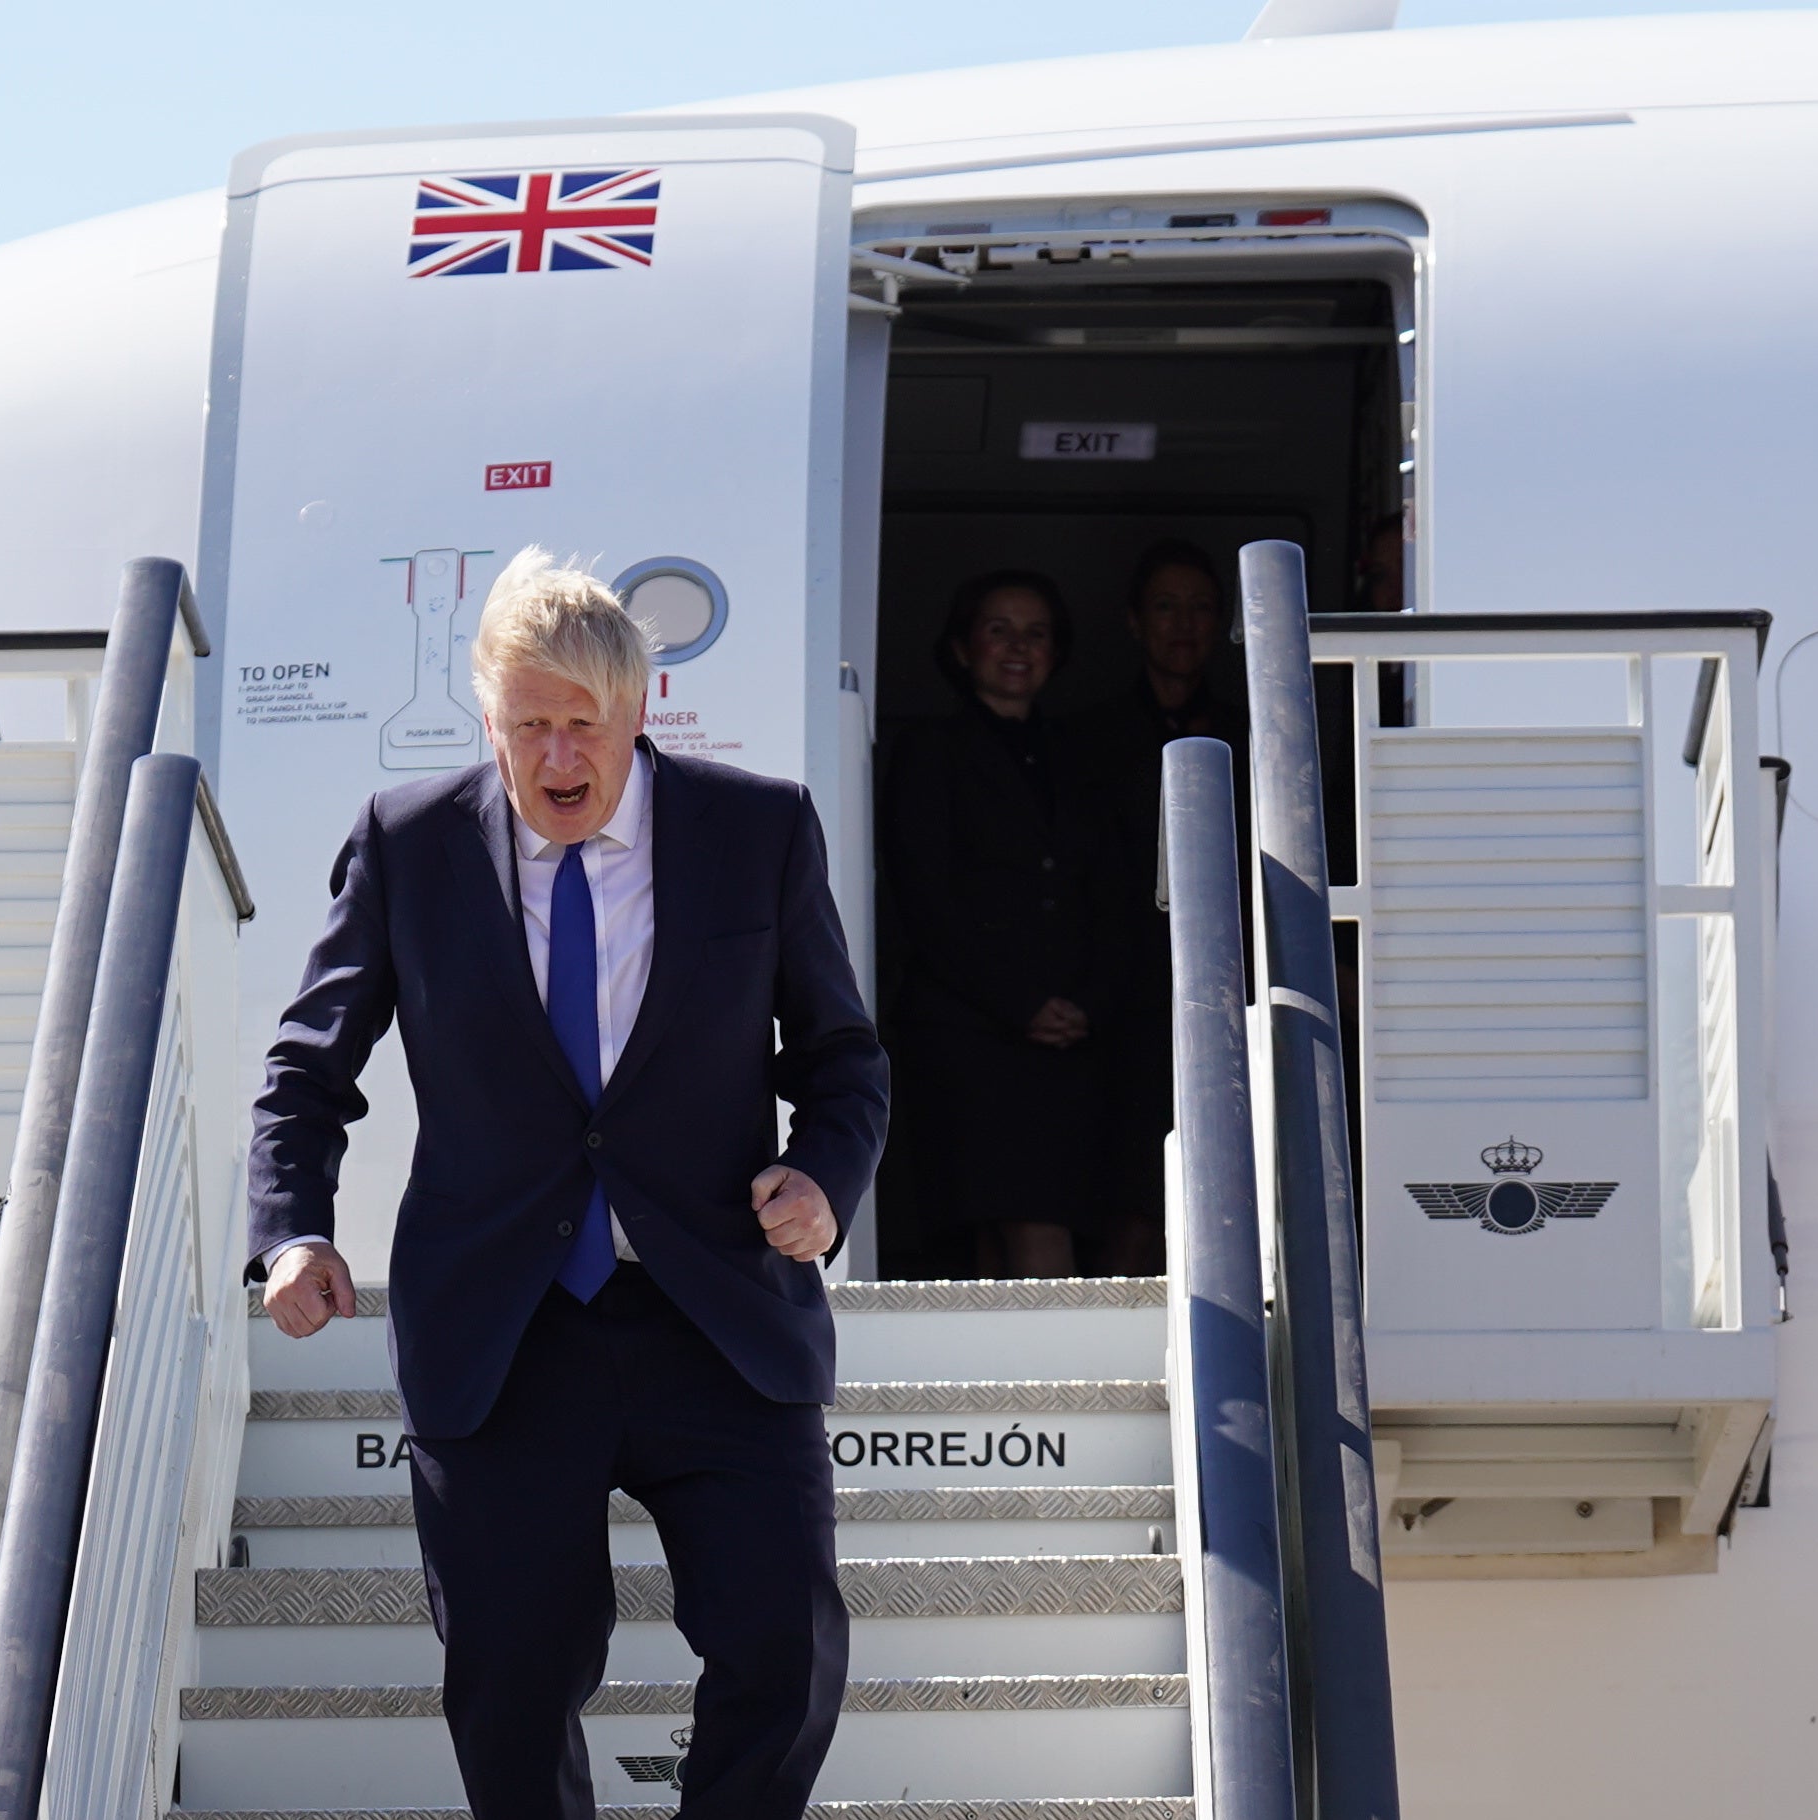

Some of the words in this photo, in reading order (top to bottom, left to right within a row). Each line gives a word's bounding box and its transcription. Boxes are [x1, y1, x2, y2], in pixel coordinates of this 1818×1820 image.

[1055, 432, 1121, 452] EXIT
[490, 465, 547, 487] EXIT
[239, 666, 266, 682] TO
[273, 662, 330, 680] OPEN
[272, 683, 294, 691] FLAP
[644, 711, 698, 725] ANGER
[827, 1422, 1065, 1467] ORREJÓN
